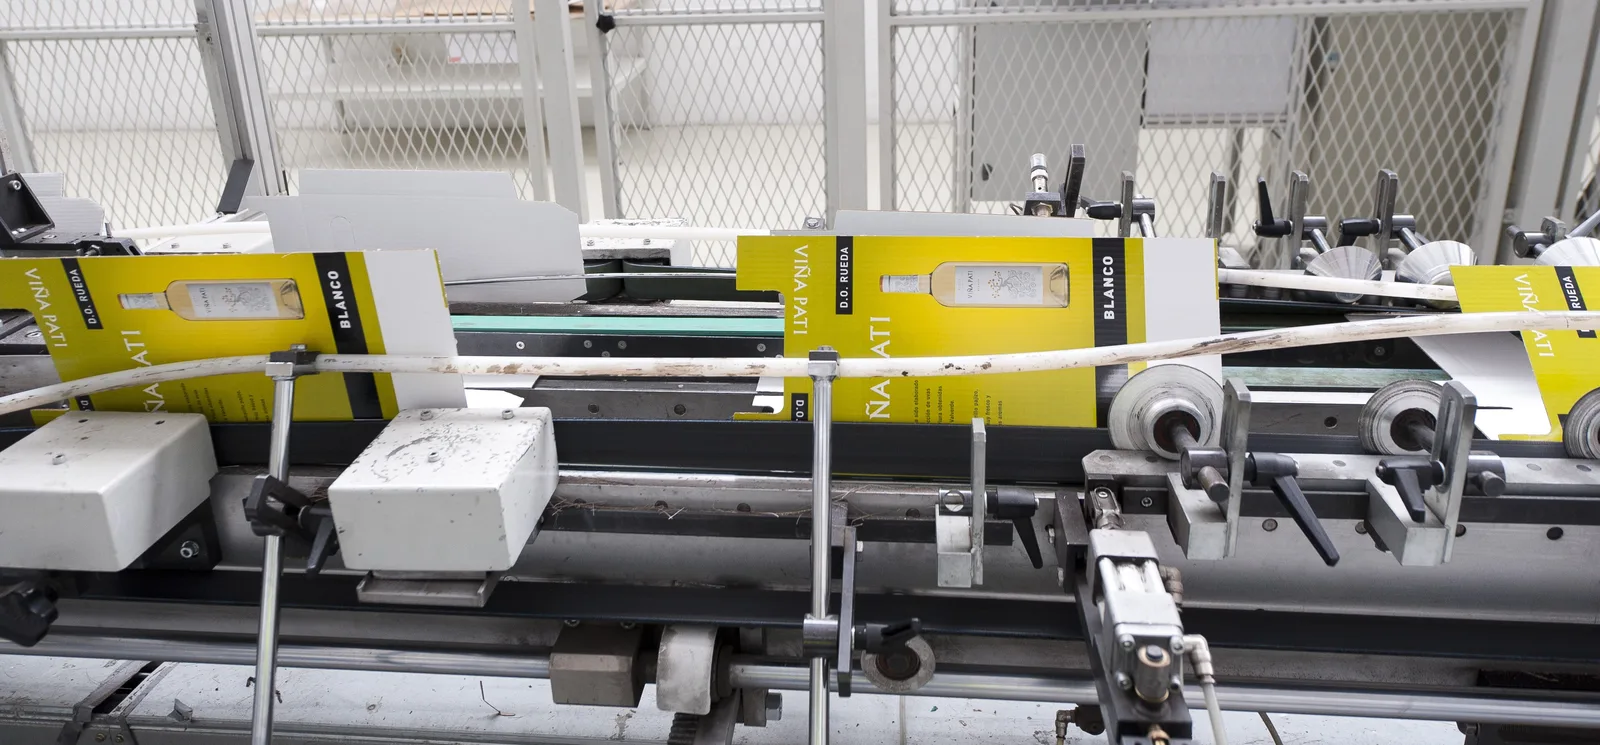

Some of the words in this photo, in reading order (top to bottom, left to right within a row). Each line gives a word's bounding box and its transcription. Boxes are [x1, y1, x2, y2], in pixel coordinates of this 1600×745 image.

[794, 244, 811, 292] VIÑA
[840, 247, 849, 283] RUEDA
[69, 269, 88, 302] RUEDA
[327, 270, 351, 329] BLANCO
[840, 287, 849, 308] D.O.
[1102, 256, 1115, 320] BLANCO
[1562, 276, 1582, 309] RUEDA
[25, 268, 51, 310] VIÑA
[43, 315, 67, 347] PATI
[84, 305, 97, 324] D.O.
[793, 297, 808, 335] PATI
[121, 330, 152, 367] ATI
[869, 316, 890, 359] ATI
[1531, 330, 1554, 357] ATI
[143, 382, 167, 413] ÑA
[865, 379, 890, 420] ÑA
